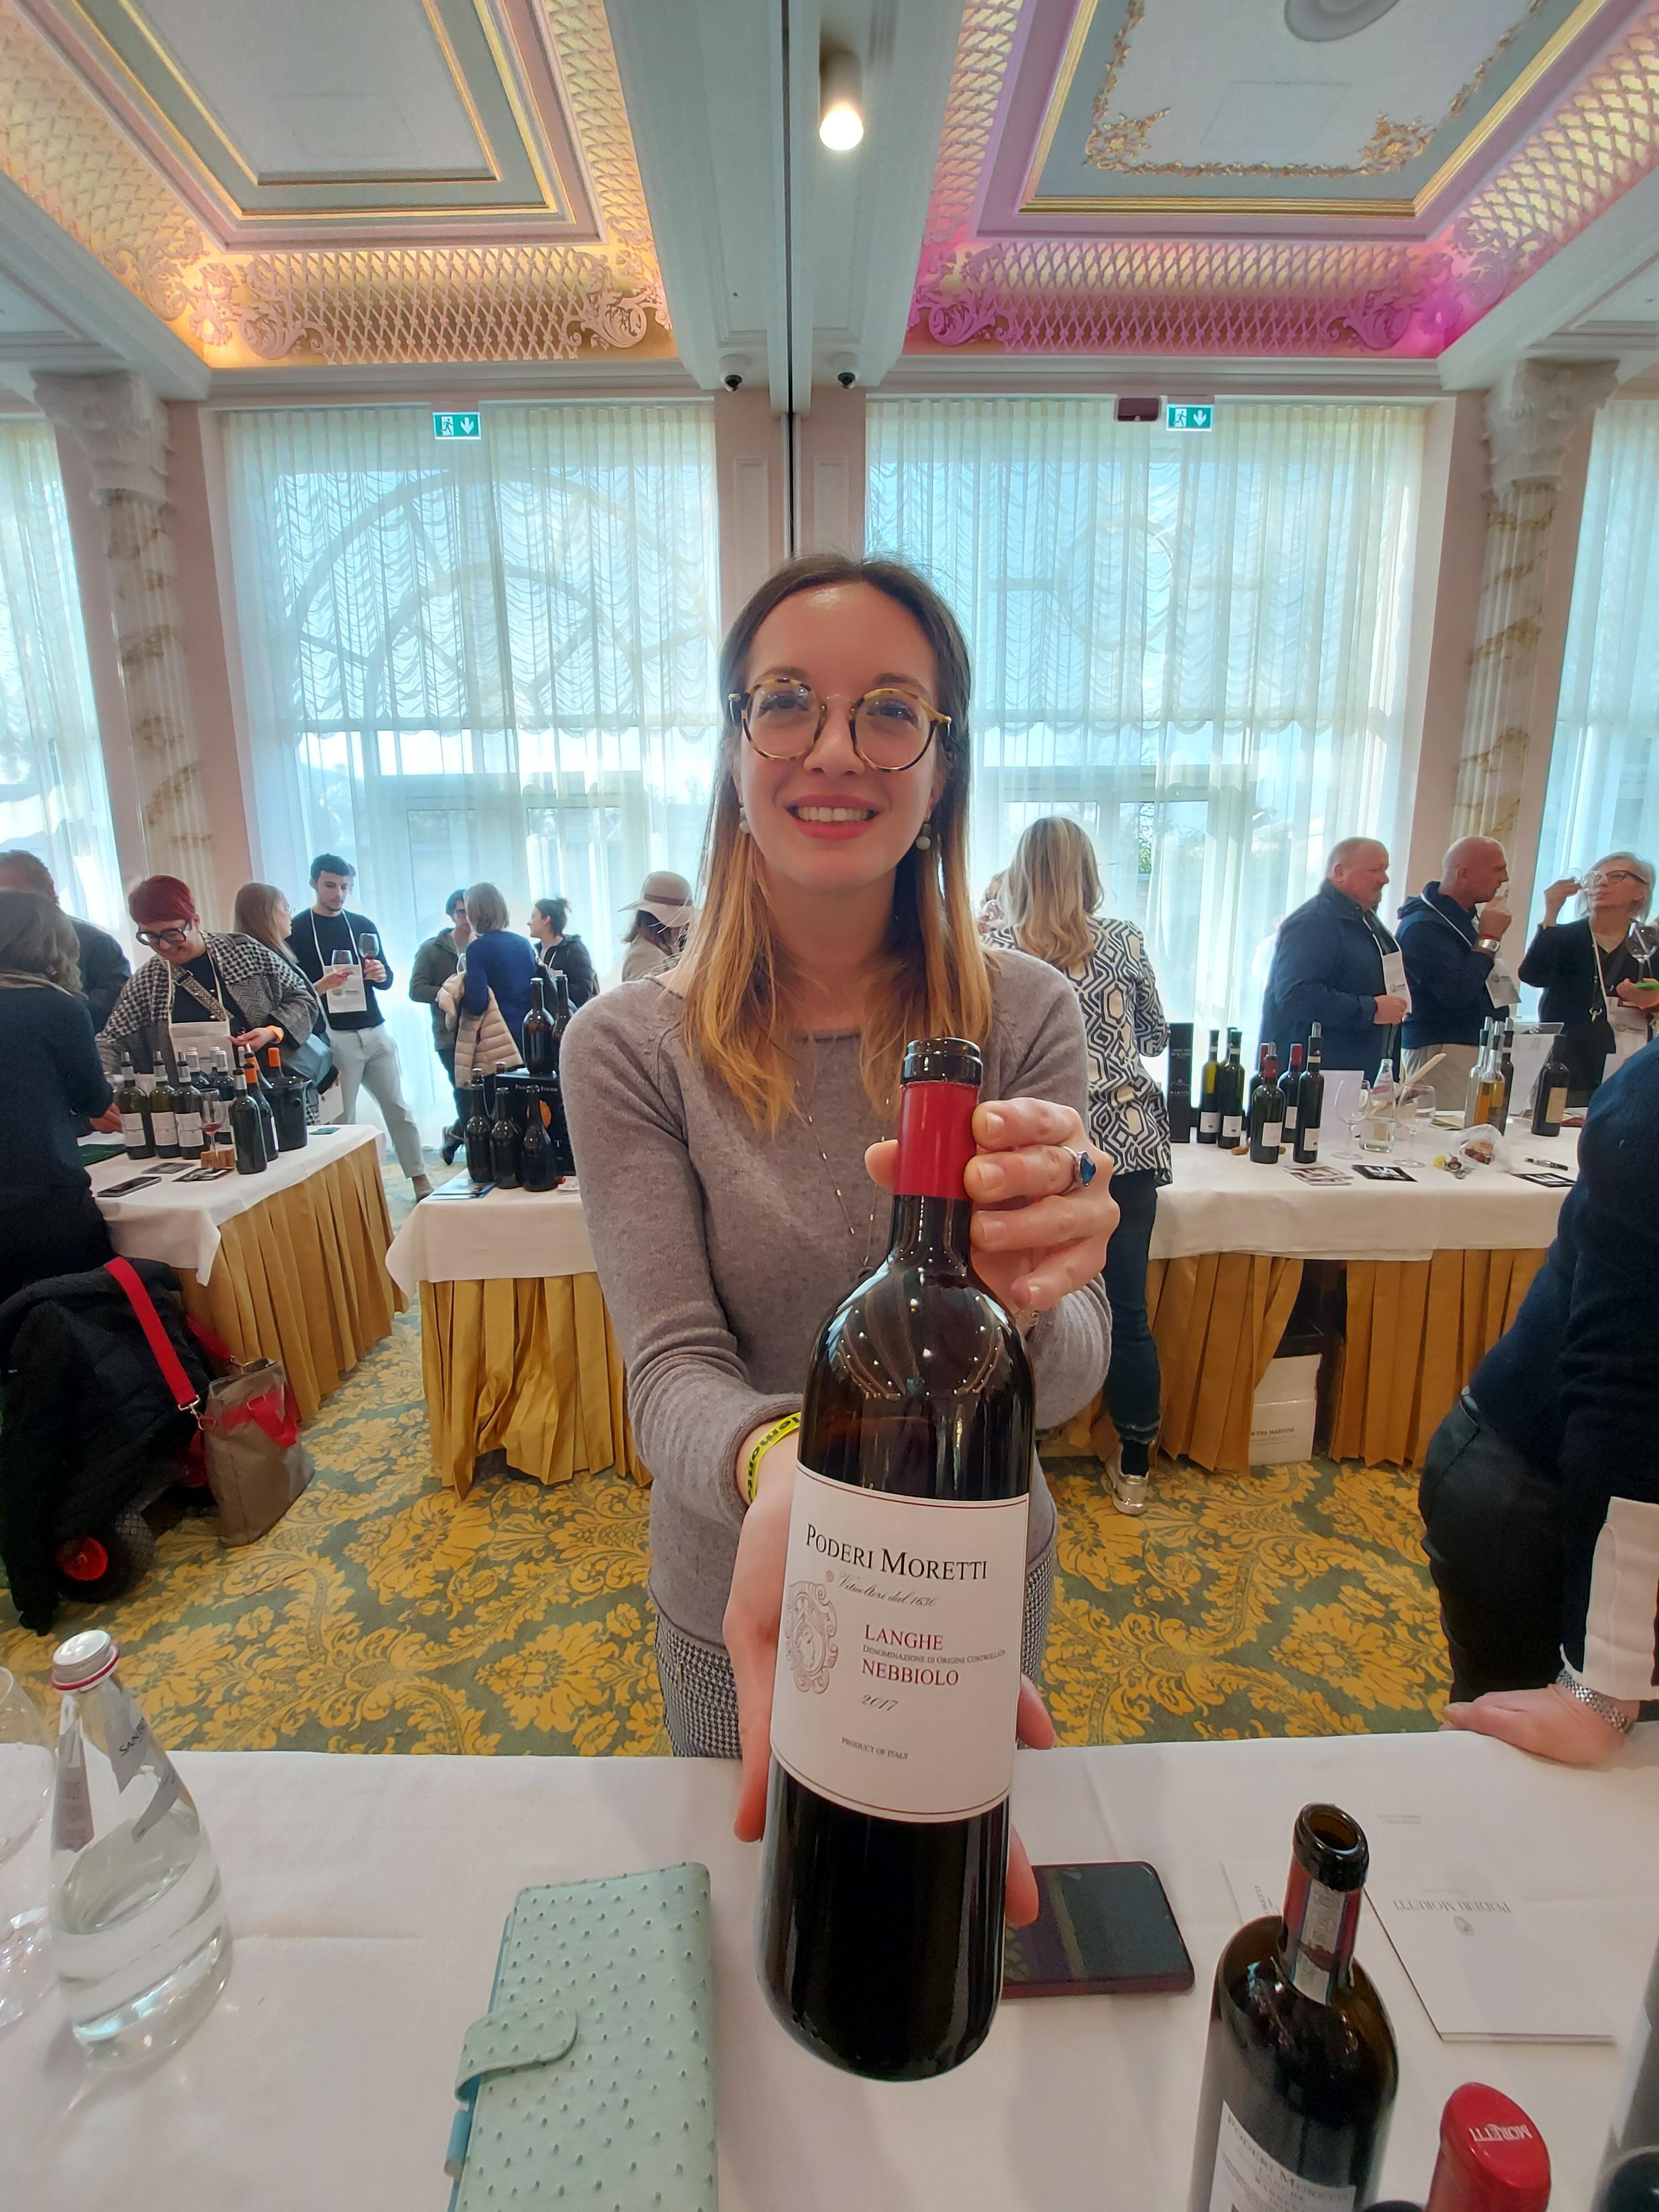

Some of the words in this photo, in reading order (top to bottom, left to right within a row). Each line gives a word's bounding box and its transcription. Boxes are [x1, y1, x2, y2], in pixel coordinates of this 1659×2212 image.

[806, 1523, 874, 1569] PODERI
[880, 1548, 988, 1580] MORETTI
[864, 1624, 943, 1651] LANGHE
[862, 1658, 959, 1686] NEBBIOLO
[862, 1694, 899, 1711] 2017
[842, 1737, 874, 1754] PRODUCT
[875, 1747, 885, 1756] OF
[888, 1750, 909, 1760] ITALY
